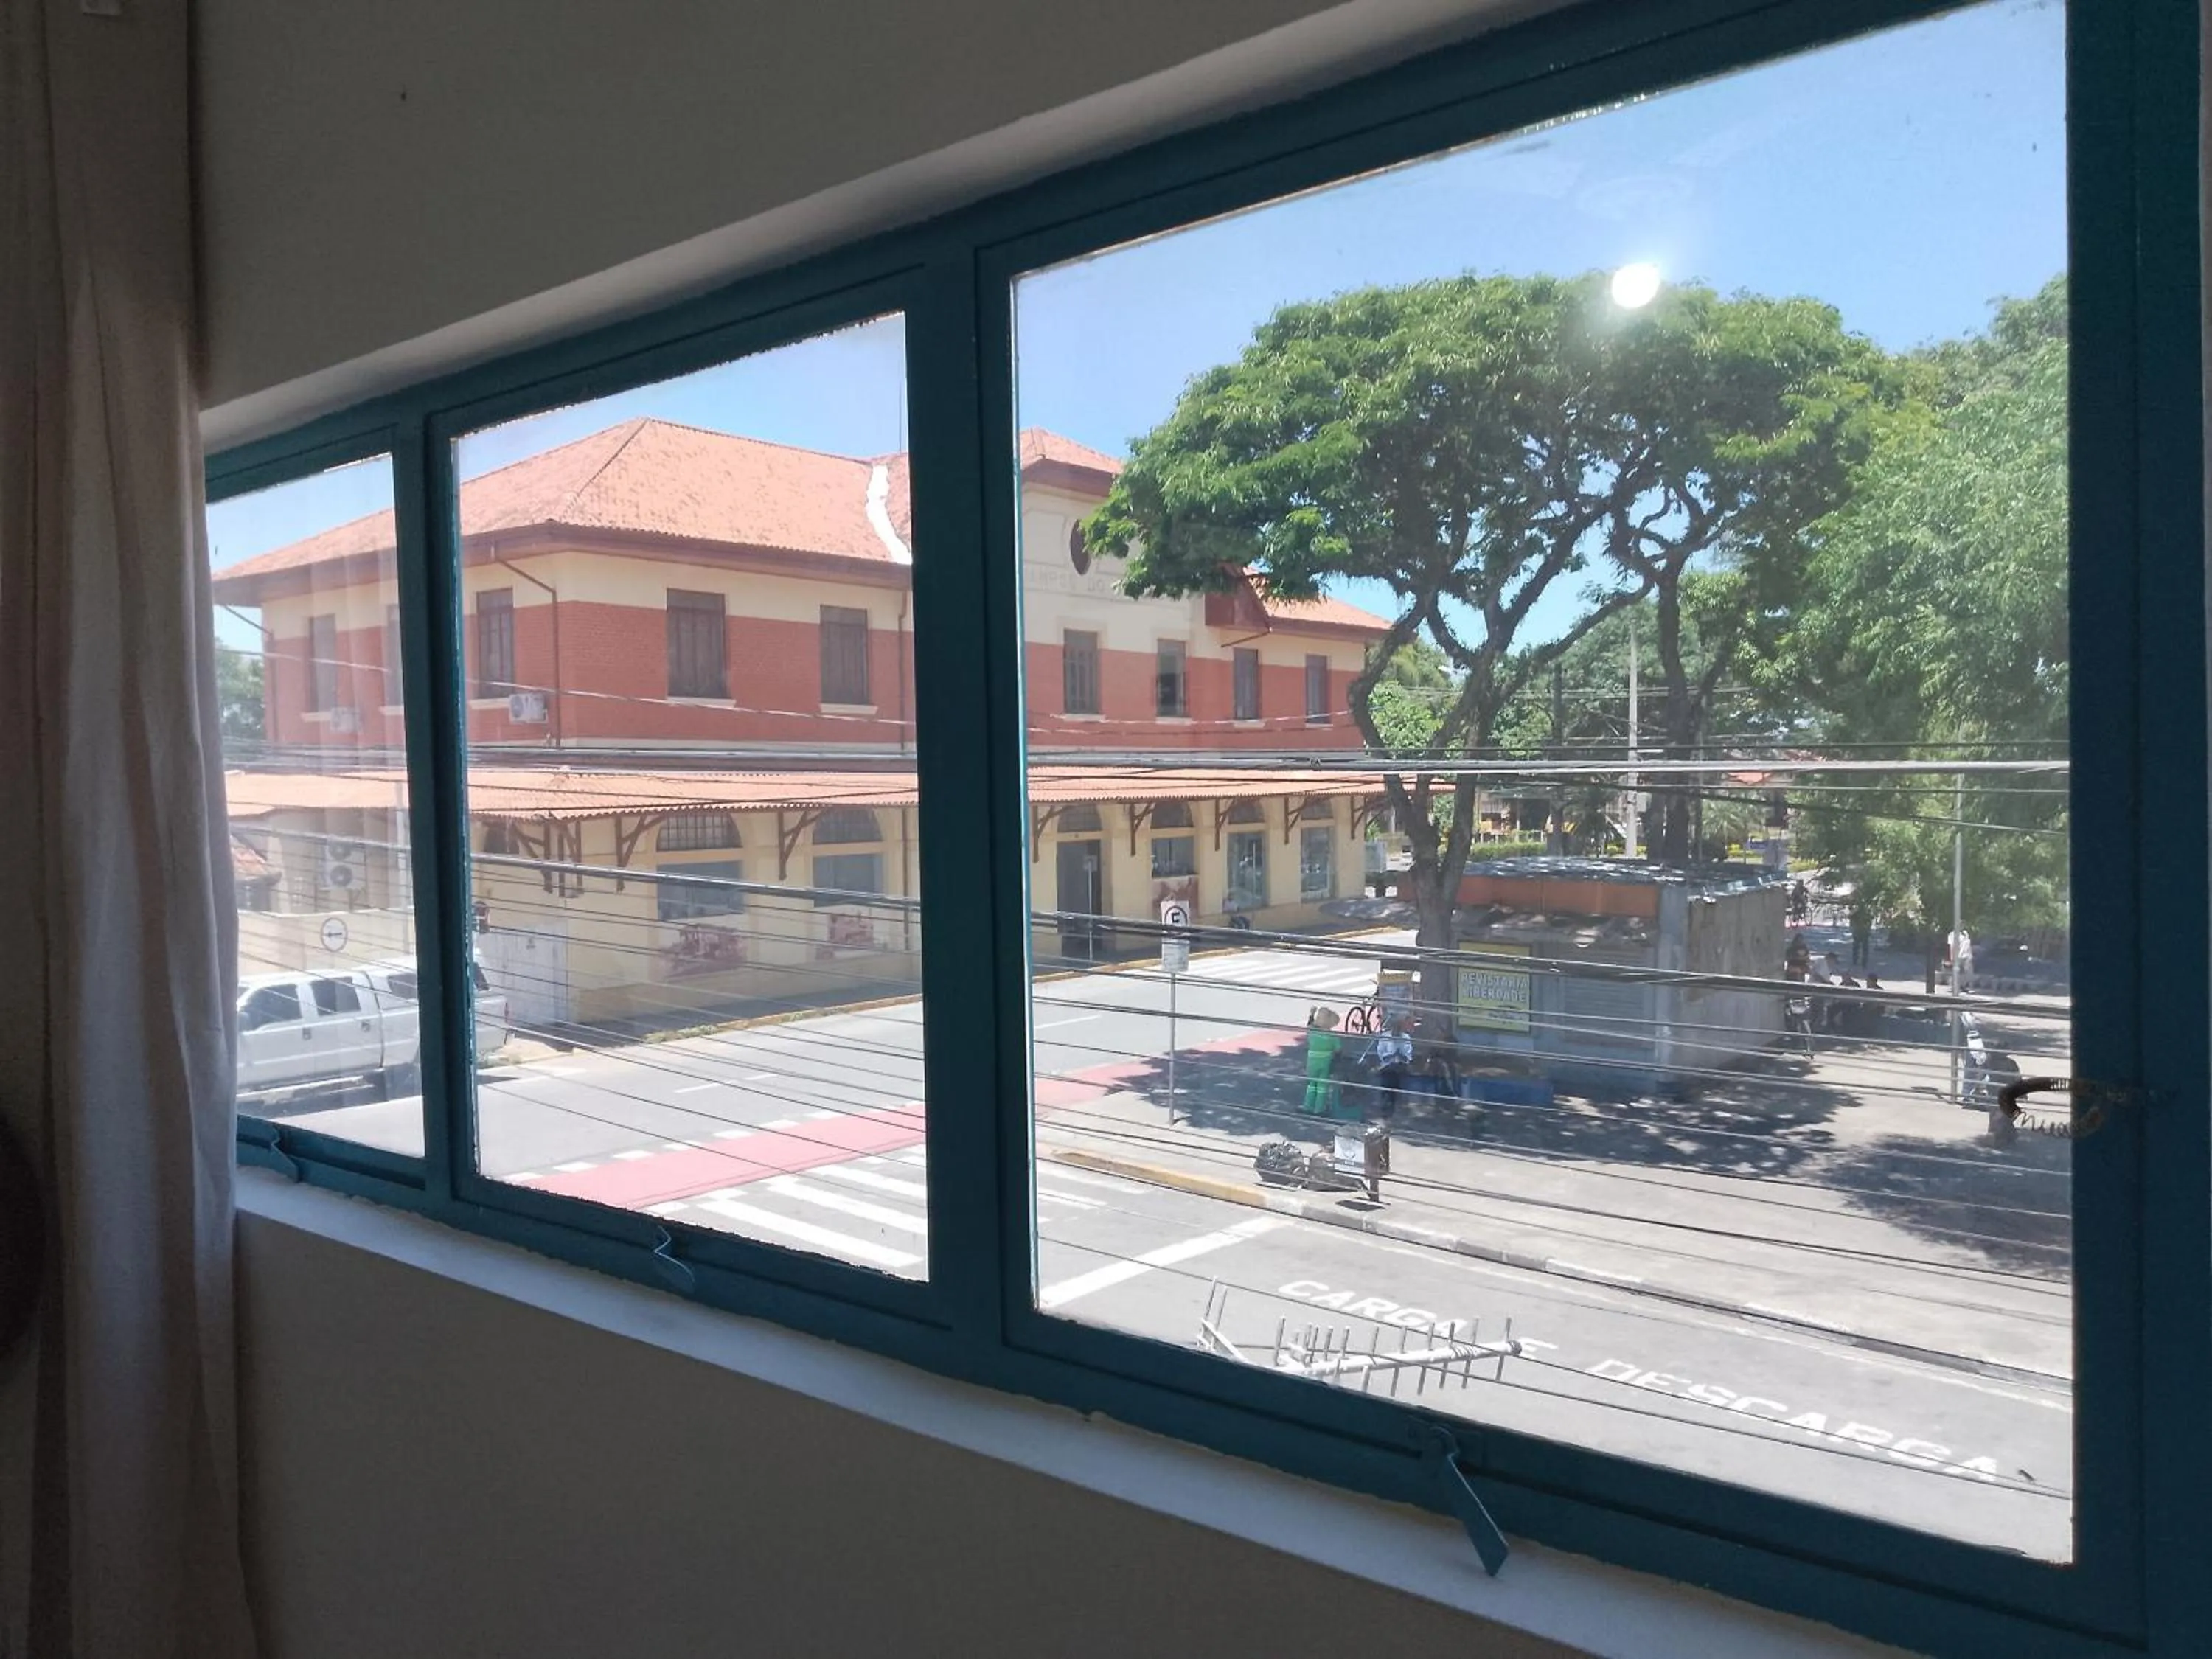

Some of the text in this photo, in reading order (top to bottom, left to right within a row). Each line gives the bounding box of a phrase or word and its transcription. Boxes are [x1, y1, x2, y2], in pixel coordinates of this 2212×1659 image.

[1461, 972, 1528, 988] REVISTARIA
[1462, 985, 1528, 1002] LIBERDADE
[1278, 1280, 1468, 1336] CARGA
[1585, 1358, 1999, 1482] DESCARGA
